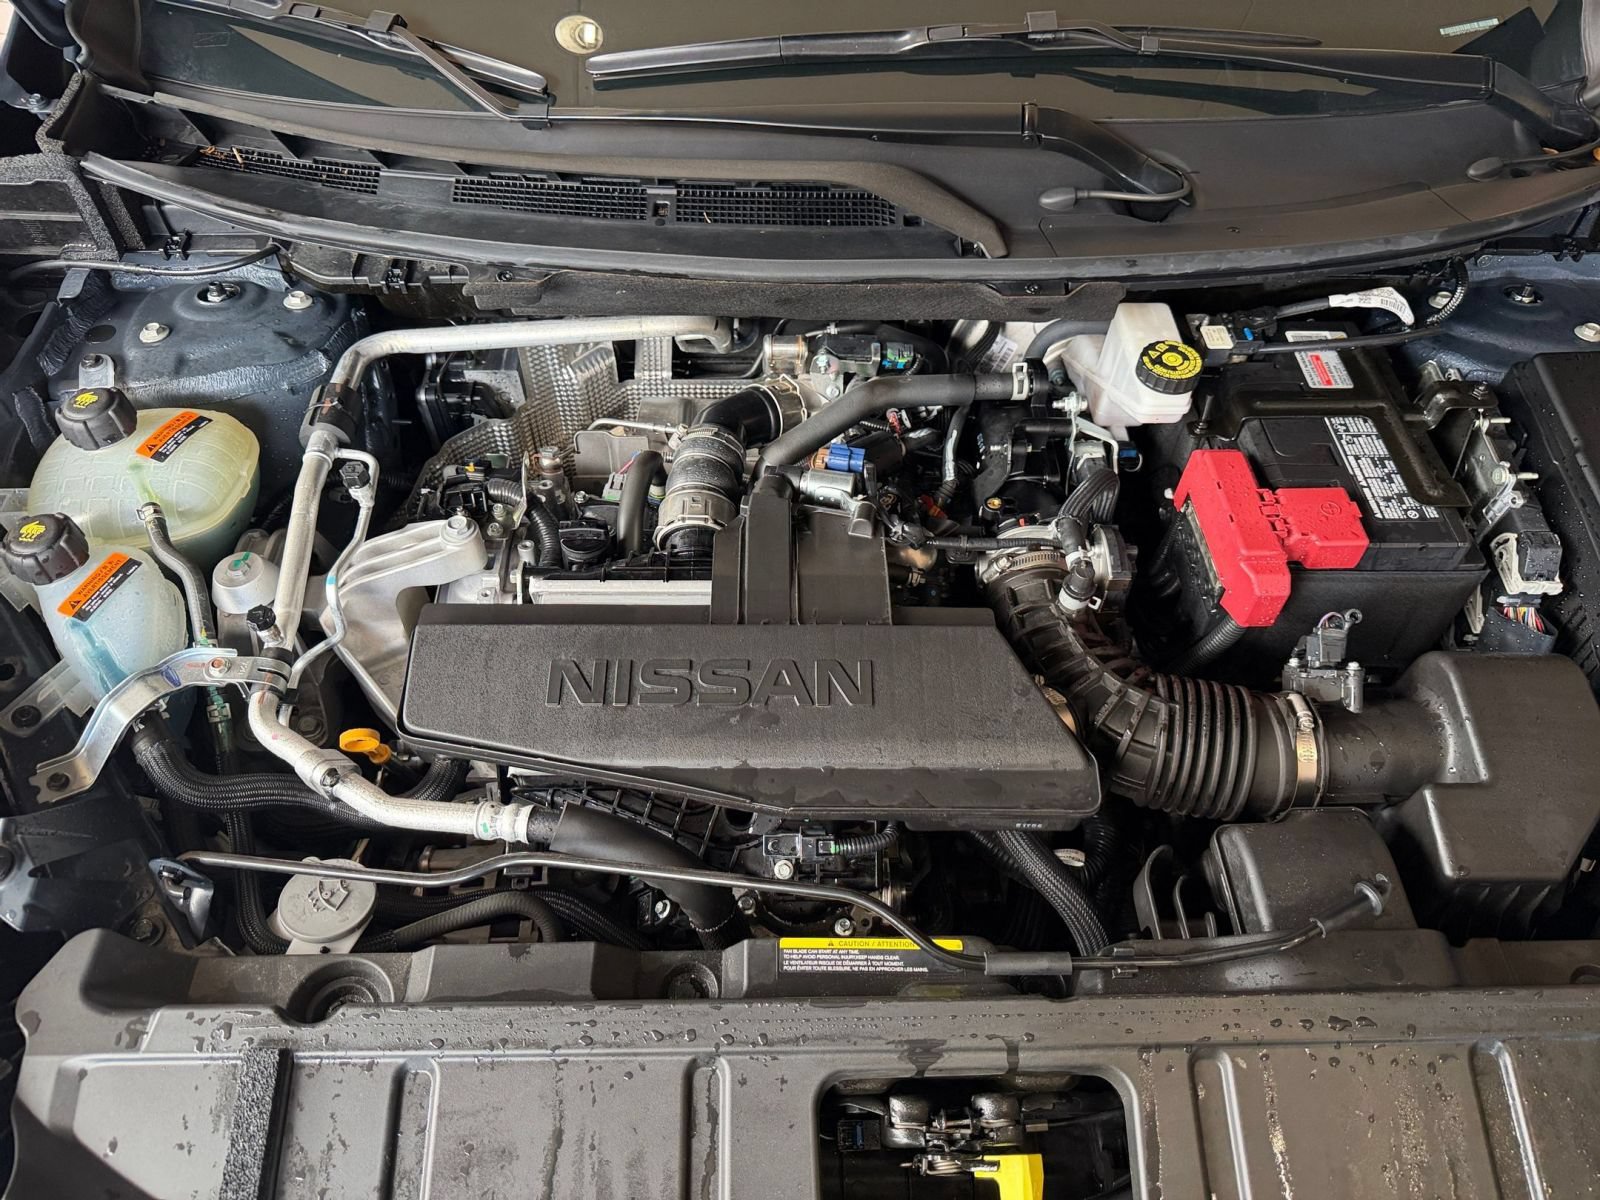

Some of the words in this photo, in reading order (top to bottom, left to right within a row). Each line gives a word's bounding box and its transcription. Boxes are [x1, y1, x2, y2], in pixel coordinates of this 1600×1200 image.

[78, 572, 101, 595] WARNING
[82, 559, 122, 598] AVERTISSEMENT
[545, 659, 875, 708] NISSAN
[876, 940, 915, 948] ATTENTION
